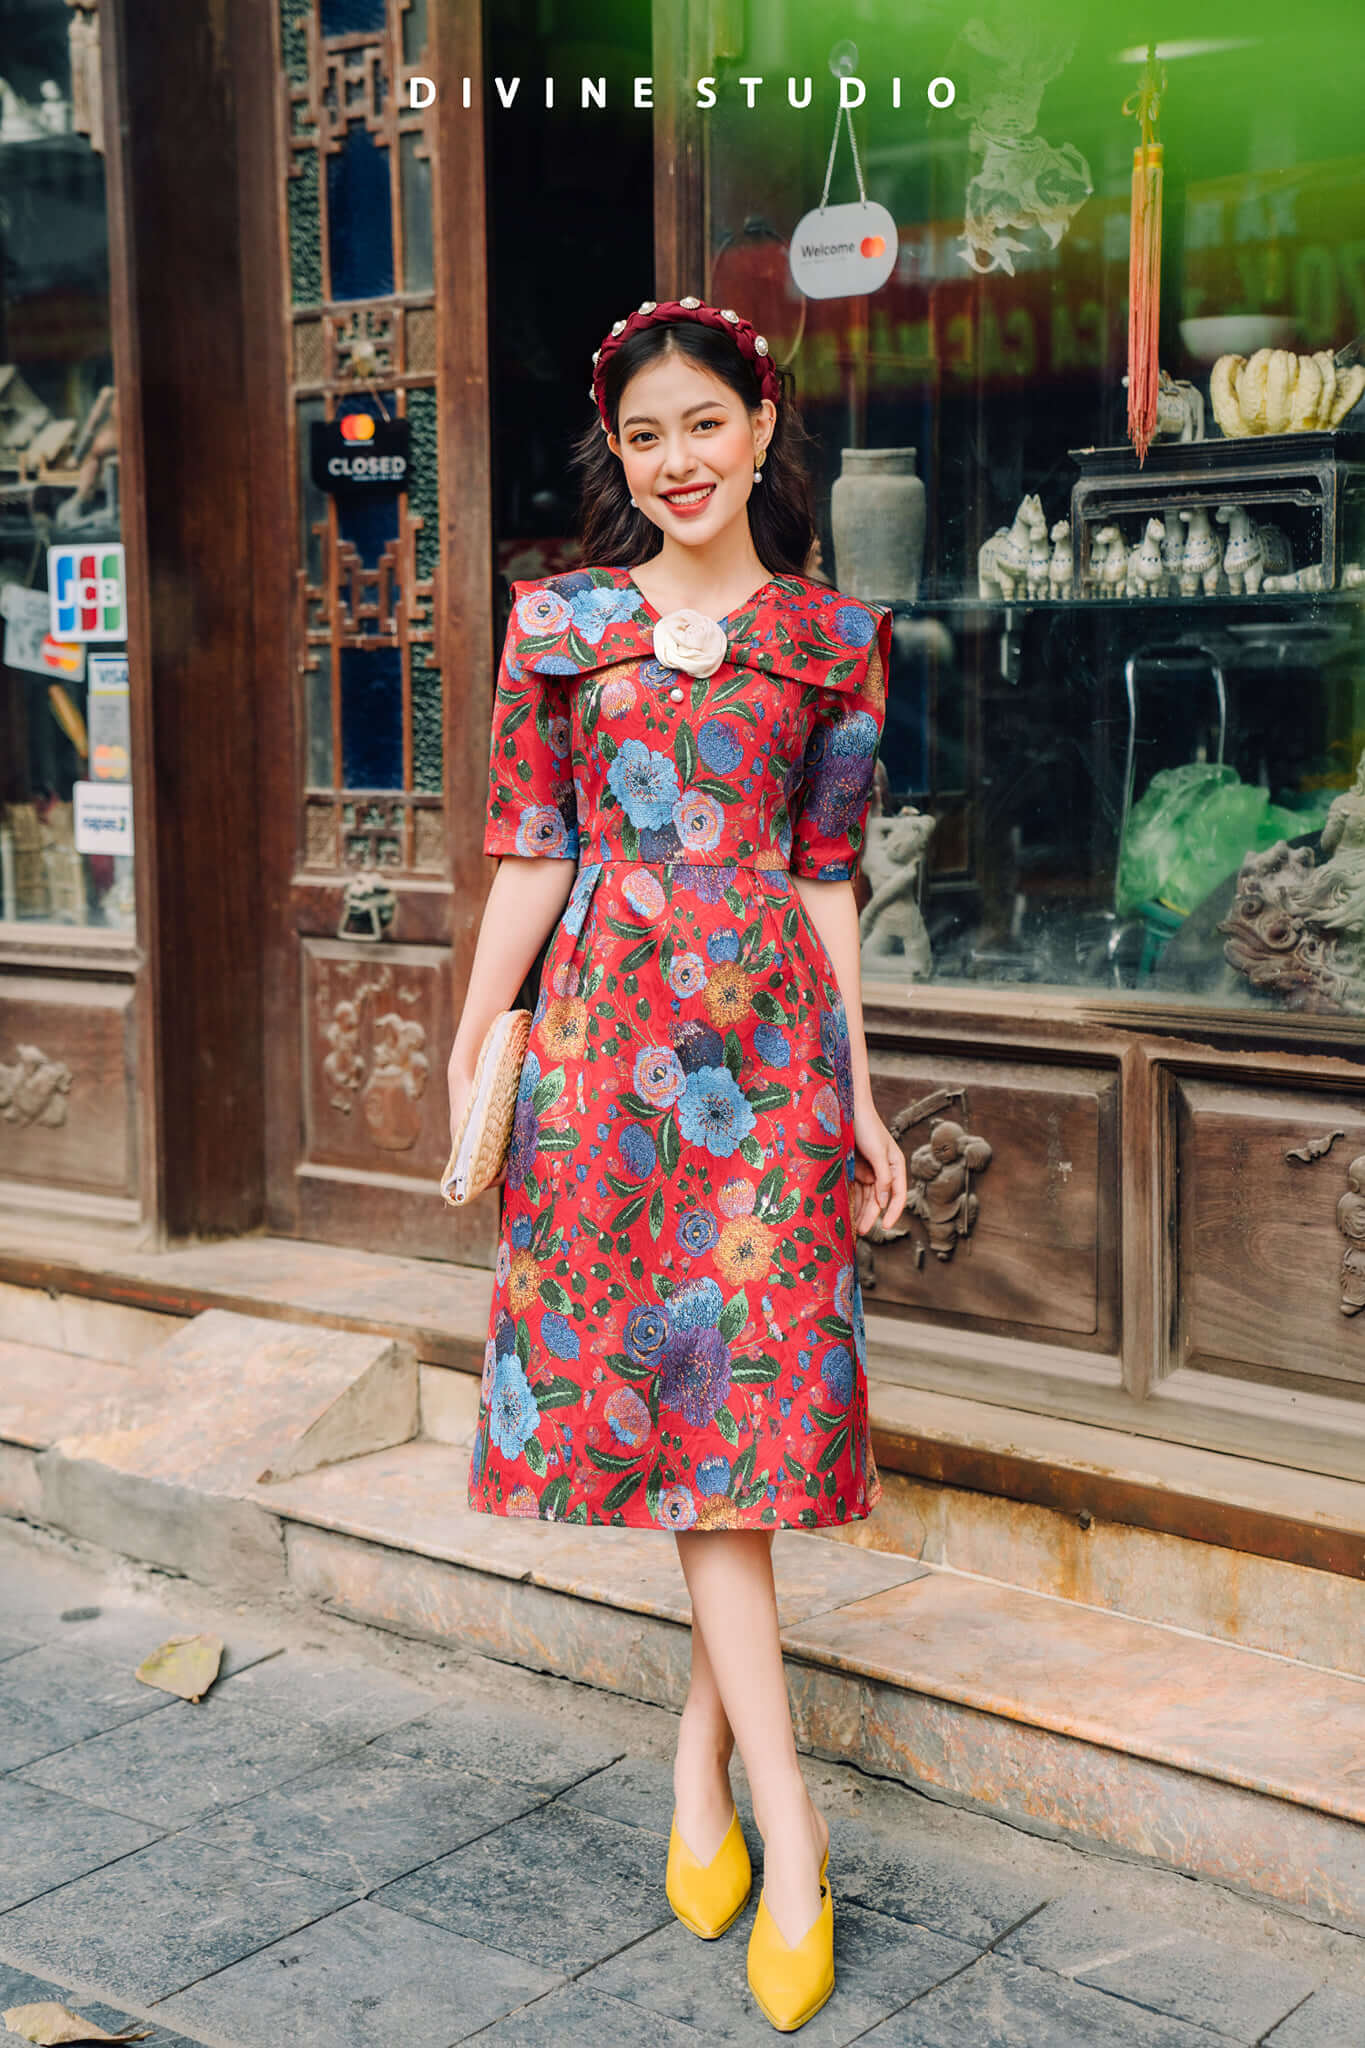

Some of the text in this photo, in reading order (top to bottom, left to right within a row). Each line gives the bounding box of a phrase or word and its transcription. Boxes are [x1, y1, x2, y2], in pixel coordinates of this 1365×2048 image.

[801, 243, 856, 258] Welcome
[328, 456, 407, 476] CLOSED
[57, 579, 121, 608] JCB
